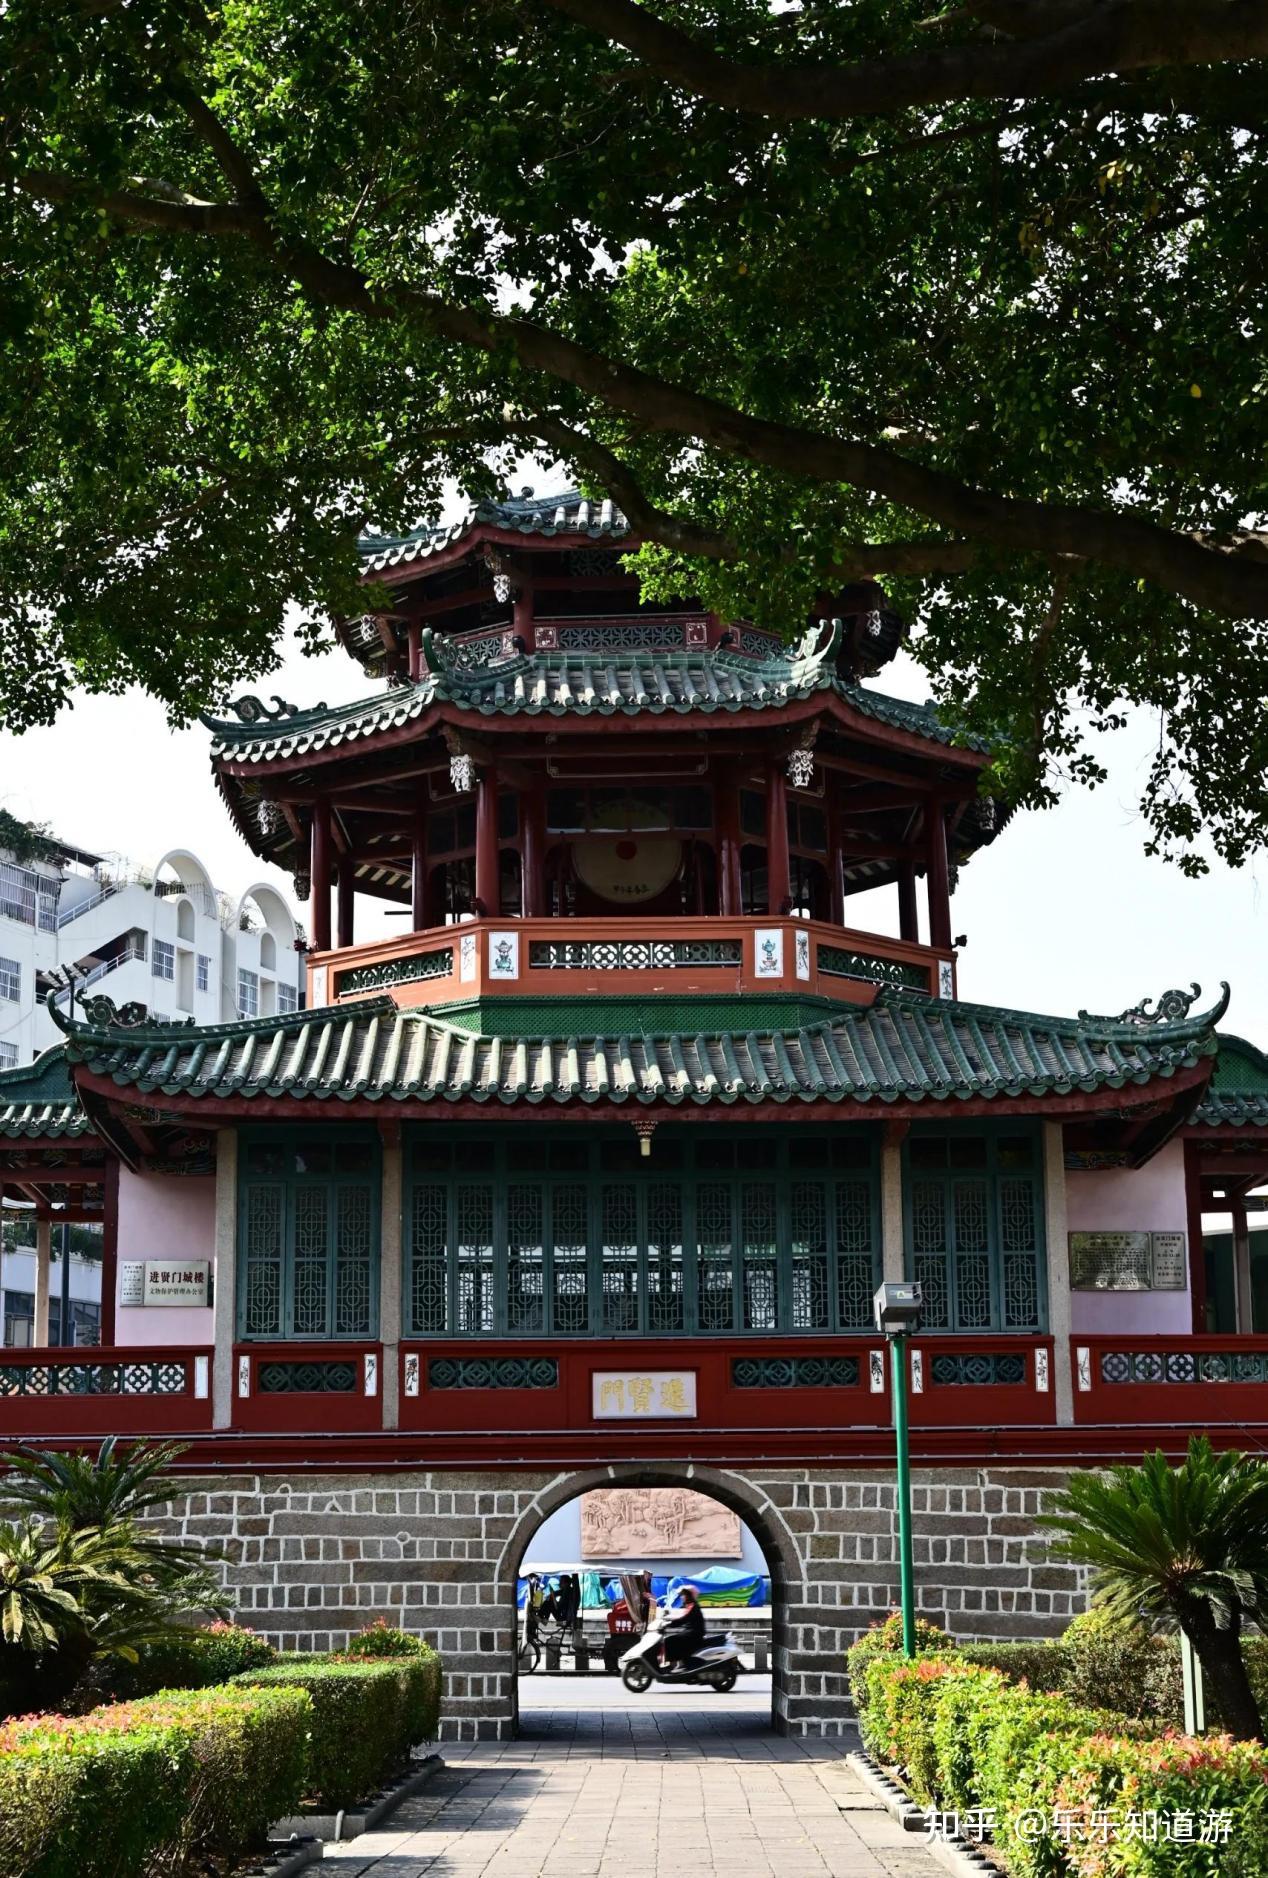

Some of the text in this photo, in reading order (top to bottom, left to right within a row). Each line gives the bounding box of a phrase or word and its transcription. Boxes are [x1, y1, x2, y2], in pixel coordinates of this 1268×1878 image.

[149, 1271, 204, 1284] 进贤门城楼
